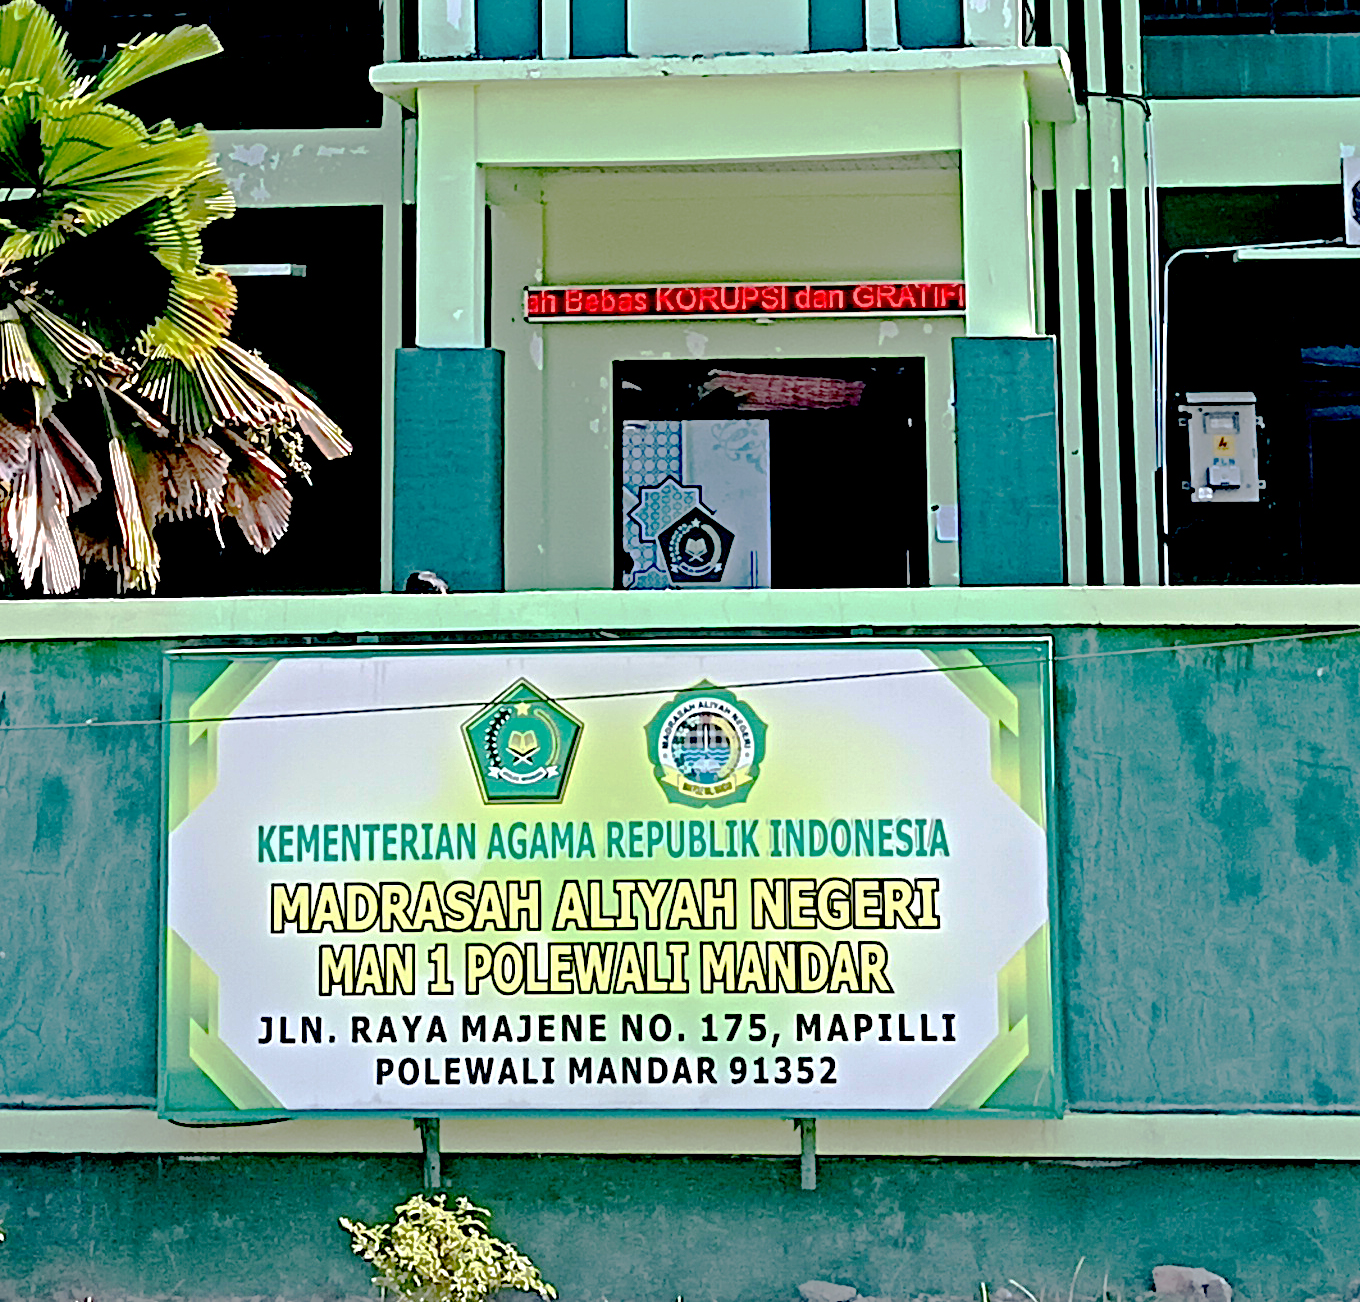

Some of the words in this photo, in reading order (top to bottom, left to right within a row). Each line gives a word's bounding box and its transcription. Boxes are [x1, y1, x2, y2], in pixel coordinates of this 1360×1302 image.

[565, 288, 647, 312] Bebas
[656, 285, 786, 312] KORUPSI
[795, 285, 844, 309] dan
[257, 822, 477, 863] KEMENTERIAN
[487, 821, 596, 861] AGAMA
[607, 819, 760, 859] REPUBLIK
[770, 818, 951, 858] INDONESIA
[270, 880, 542, 934] MADRASAH
[553, 879, 737, 931] ALIYAH
[751, 877, 940, 930] NEGERI
[318, 944, 416, 996] MAN
[428, 944, 454, 995] 1
[465, 942, 689, 995] POLEWALI
[700, 941, 895, 994] MANDAR
[257, 1016, 336, 1045] JLN.
[351, 1015, 448, 1043] RAYA
[462, 1014, 607, 1043] MAJENE
[621, 1014, 686, 1042] NO.
[701, 1013, 780, 1048] 175,
[796, 1013, 957, 1042] MAPILLI
[376, 1057, 555, 1085] POLEWALI
[569, 1057, 718, 1085] MANDAR
[730, 1056, 838, 1085] 91352
